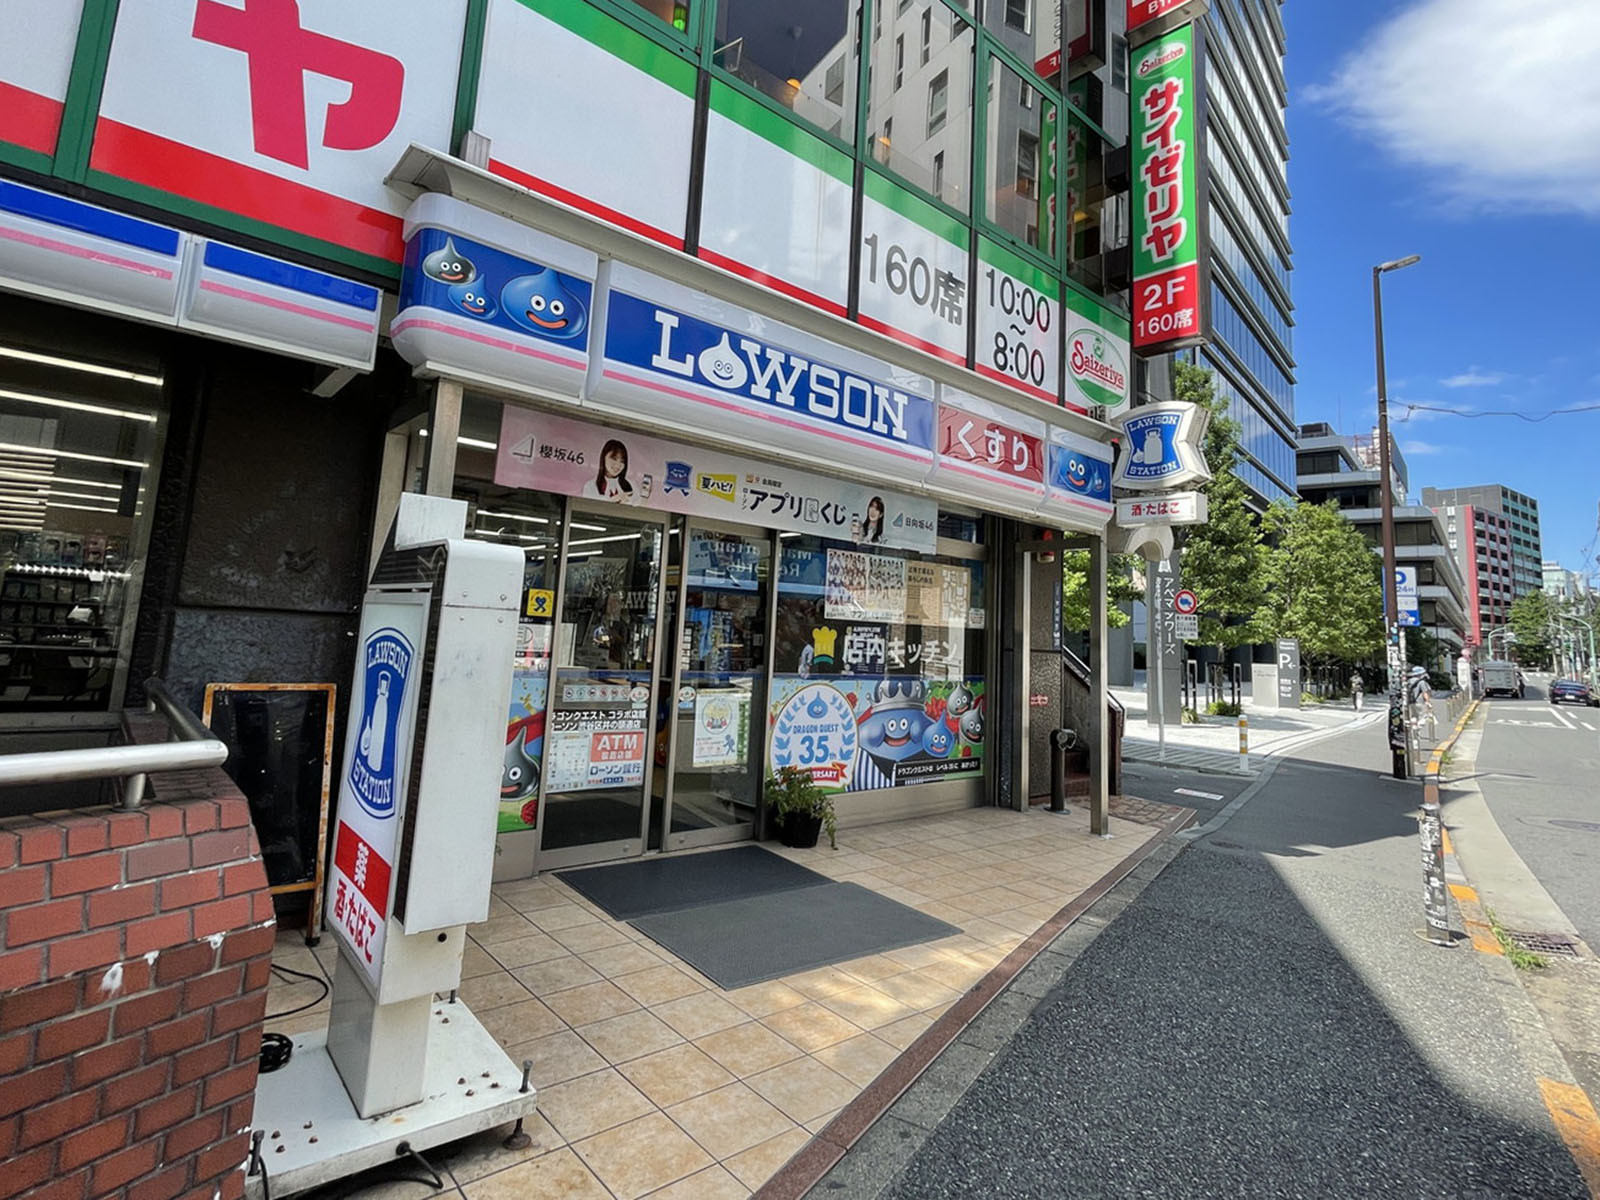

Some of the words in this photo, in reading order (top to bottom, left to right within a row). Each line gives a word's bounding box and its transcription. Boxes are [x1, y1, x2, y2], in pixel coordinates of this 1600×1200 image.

[1143, 79, 1184, 260] サイゼリヤ
[865, 233, 966, 326] 160席
[1143, 276, 1186, 311] 2F
[986, 268, 1050, 333] 10:00
[1137, 308, 1193, 337] 160席
[651, 309, 909, 440] LWSON
[993, 332, 1045, 387] 8:00
[1070, 340, 1125, 386] Saizeriya
[1128, 415, 1178, 431] LAWSON
[957, 420, 1029, 472] くすり
[1129, 460, 1178, 476] STATION
[749, 489, 803, 519] アプリ
[820, 502, 847, 526] くじ
[366, 641, 409, 678] LAWSON
[1279, 653, 1291, 669] P
[597, 735, 638, 751] ATM
[799, 735, 829, 764] 35
[353, 757, 392, 805] STATION
[354, 842, 370, 891] 薬
